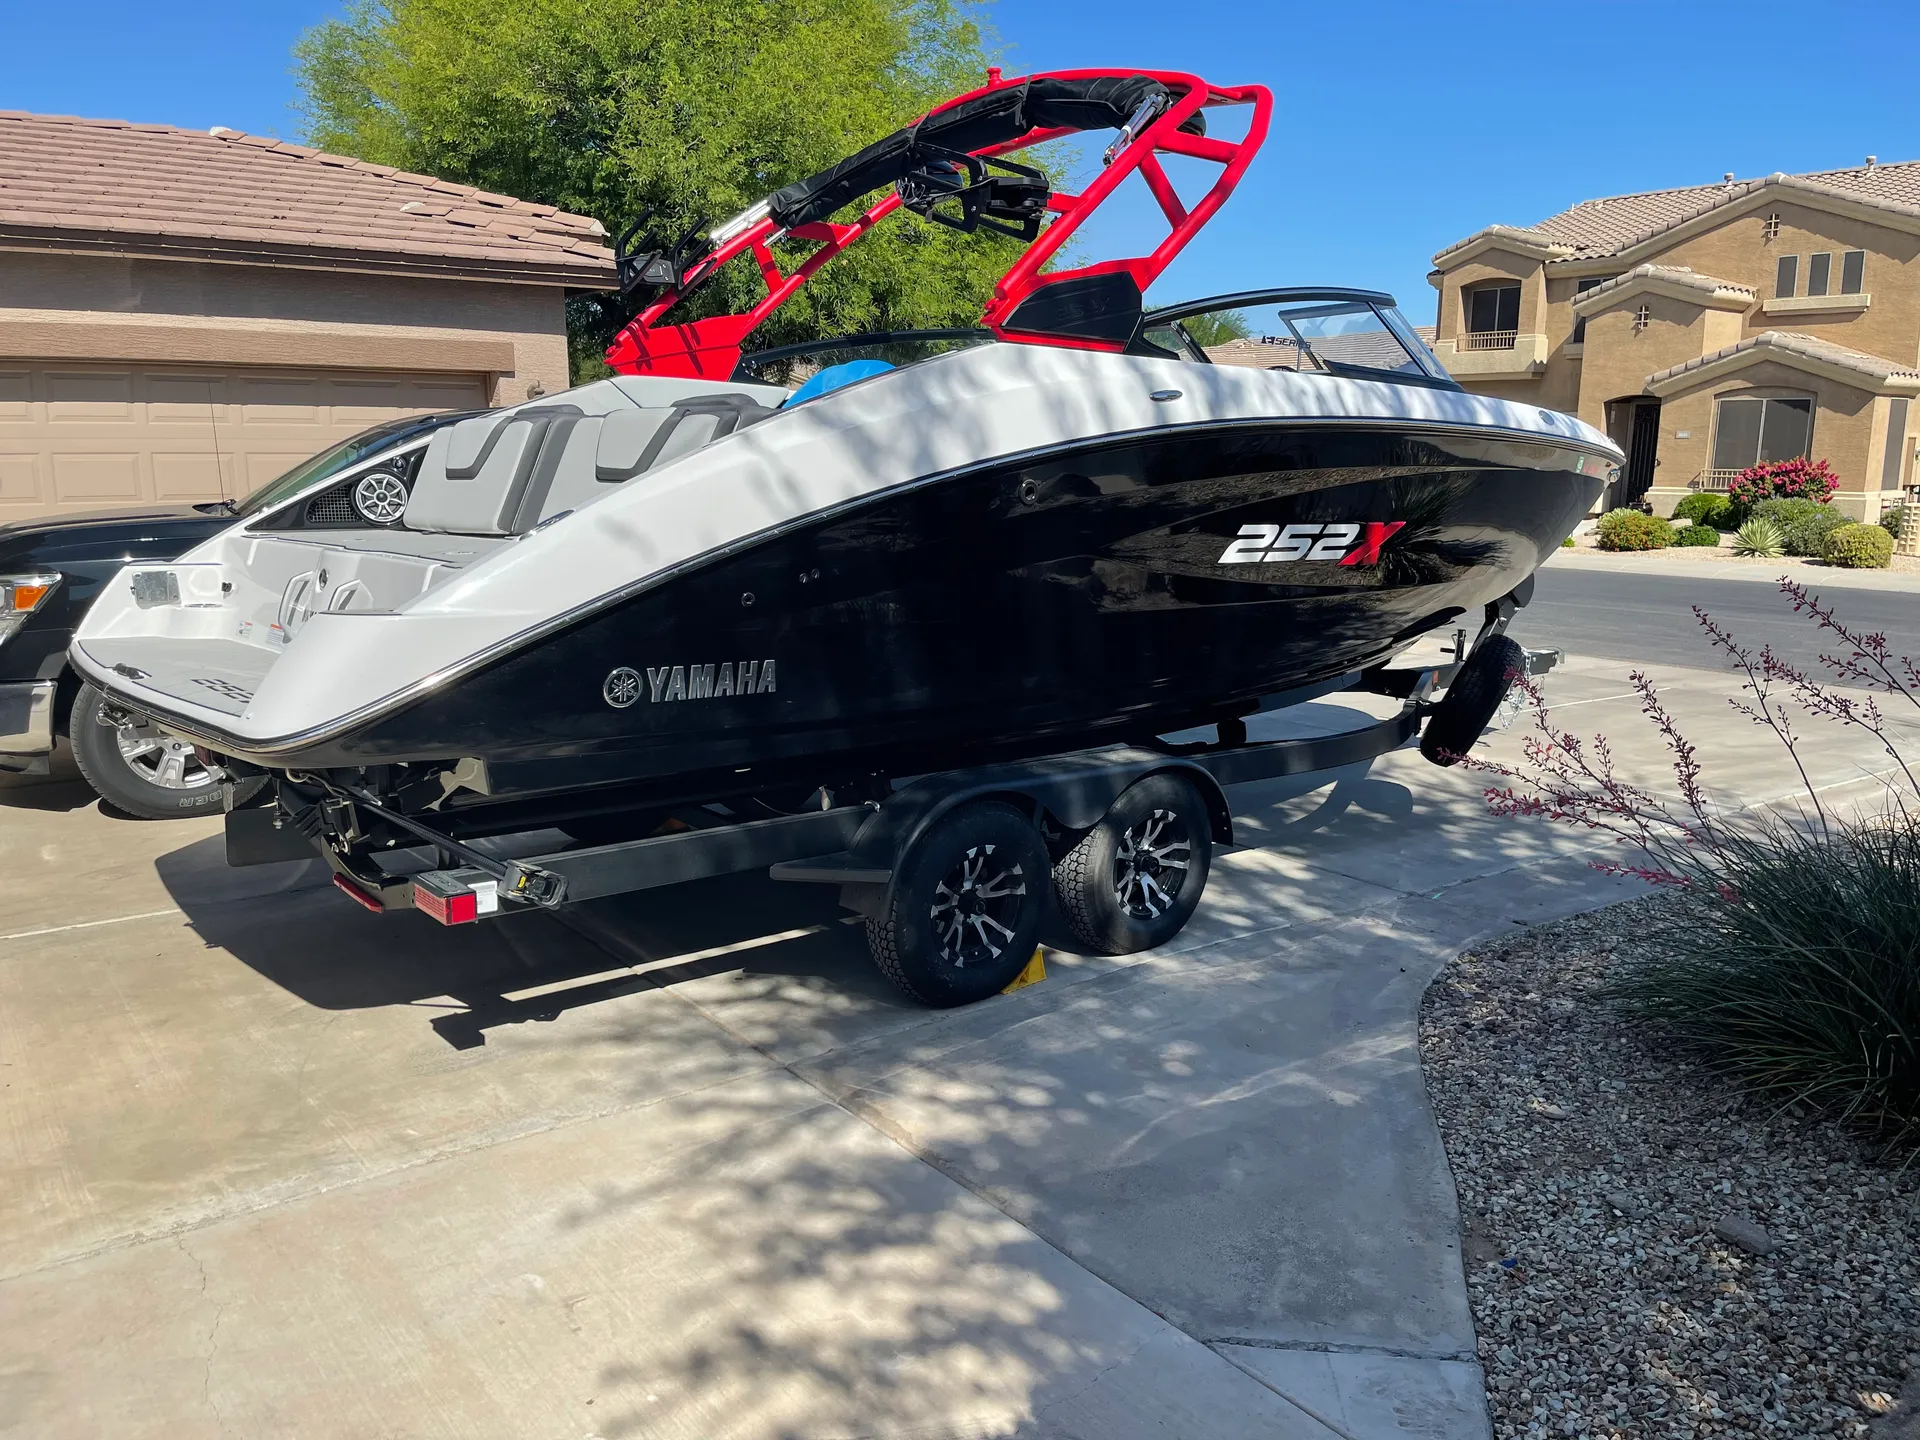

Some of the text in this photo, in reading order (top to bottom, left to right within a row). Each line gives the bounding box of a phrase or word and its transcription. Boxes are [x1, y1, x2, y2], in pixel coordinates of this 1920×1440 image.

[1275, 337, 1311, 350] SERIS
[1217, 521, 1407, 566] 252X
[190, 678, 255, 704] 252
[646, 659, 777, 703] YAMAHA
[179, 784, 235, 807] BER
